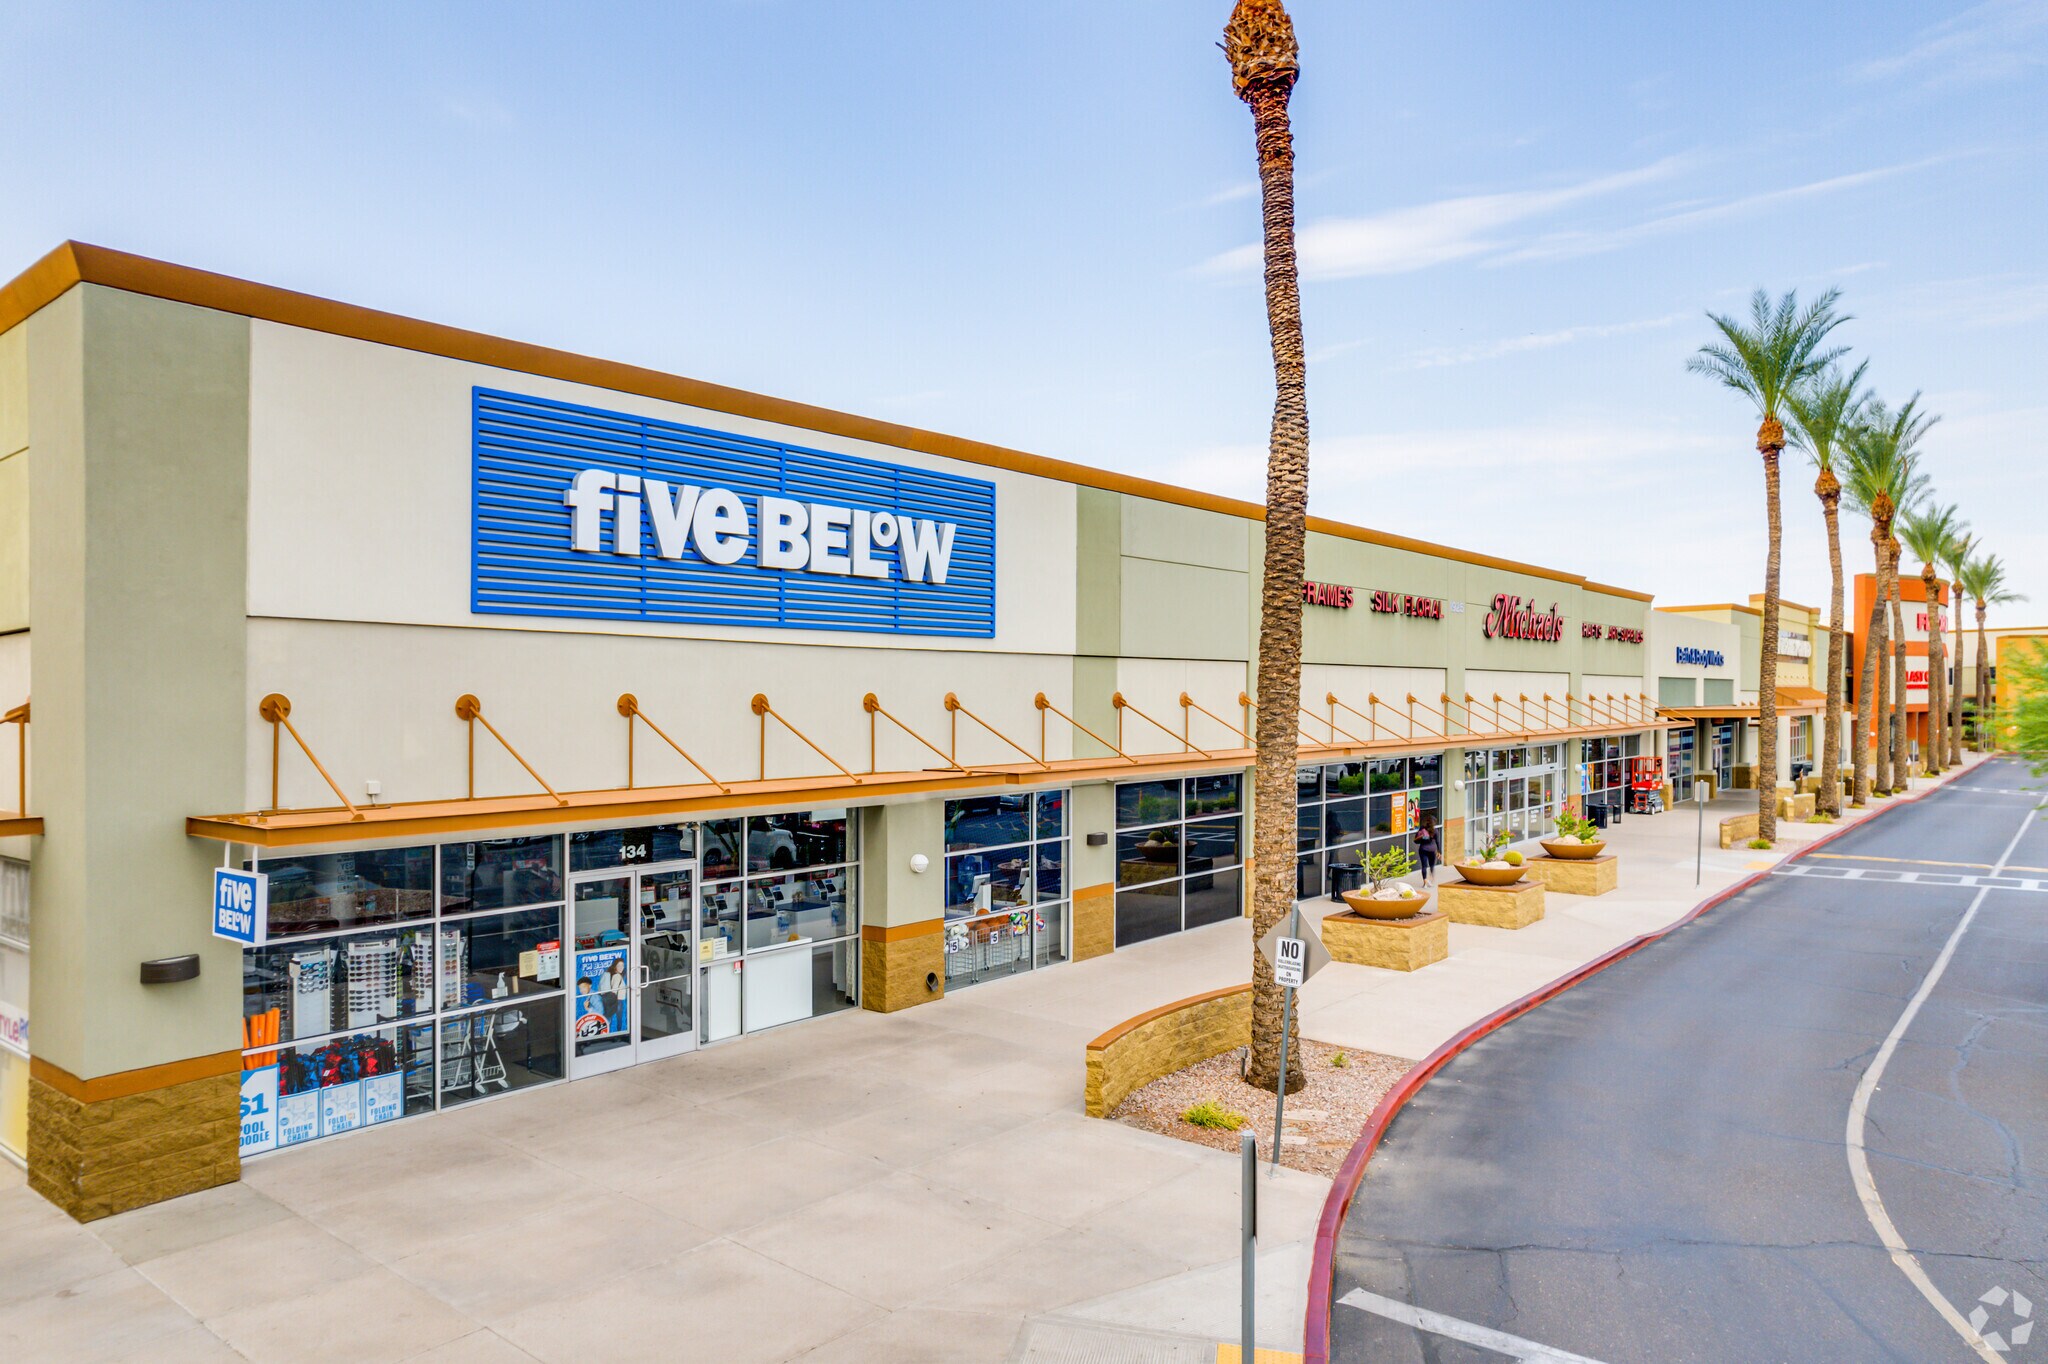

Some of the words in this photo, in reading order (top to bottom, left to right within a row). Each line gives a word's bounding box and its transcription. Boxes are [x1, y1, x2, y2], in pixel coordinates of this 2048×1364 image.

[563, 469, 749, 564] five
[1372, 591, 1399, 613] SILK
[1404, 595, 1445, 619] FLORAL
[1483, 593, 1564, 641] Michaels
[619, 844, 647, 860] 134
[220, 877, 252, 912] five
[1281, 941, 1299, 959] NO
[1278, 976, 1299, 985] PROPERTY
[370, 1103, 397, 1116] FOLDING
[374, 1110, 394, 1122] CHAIR
[328, 1113, 355, 1126] FOLDI
[331, 1120, 352, 1132] CHAIR
[283, 1123, 313, 1136] FOLDING
[287, 1131, 309, 1143] CHAIR
